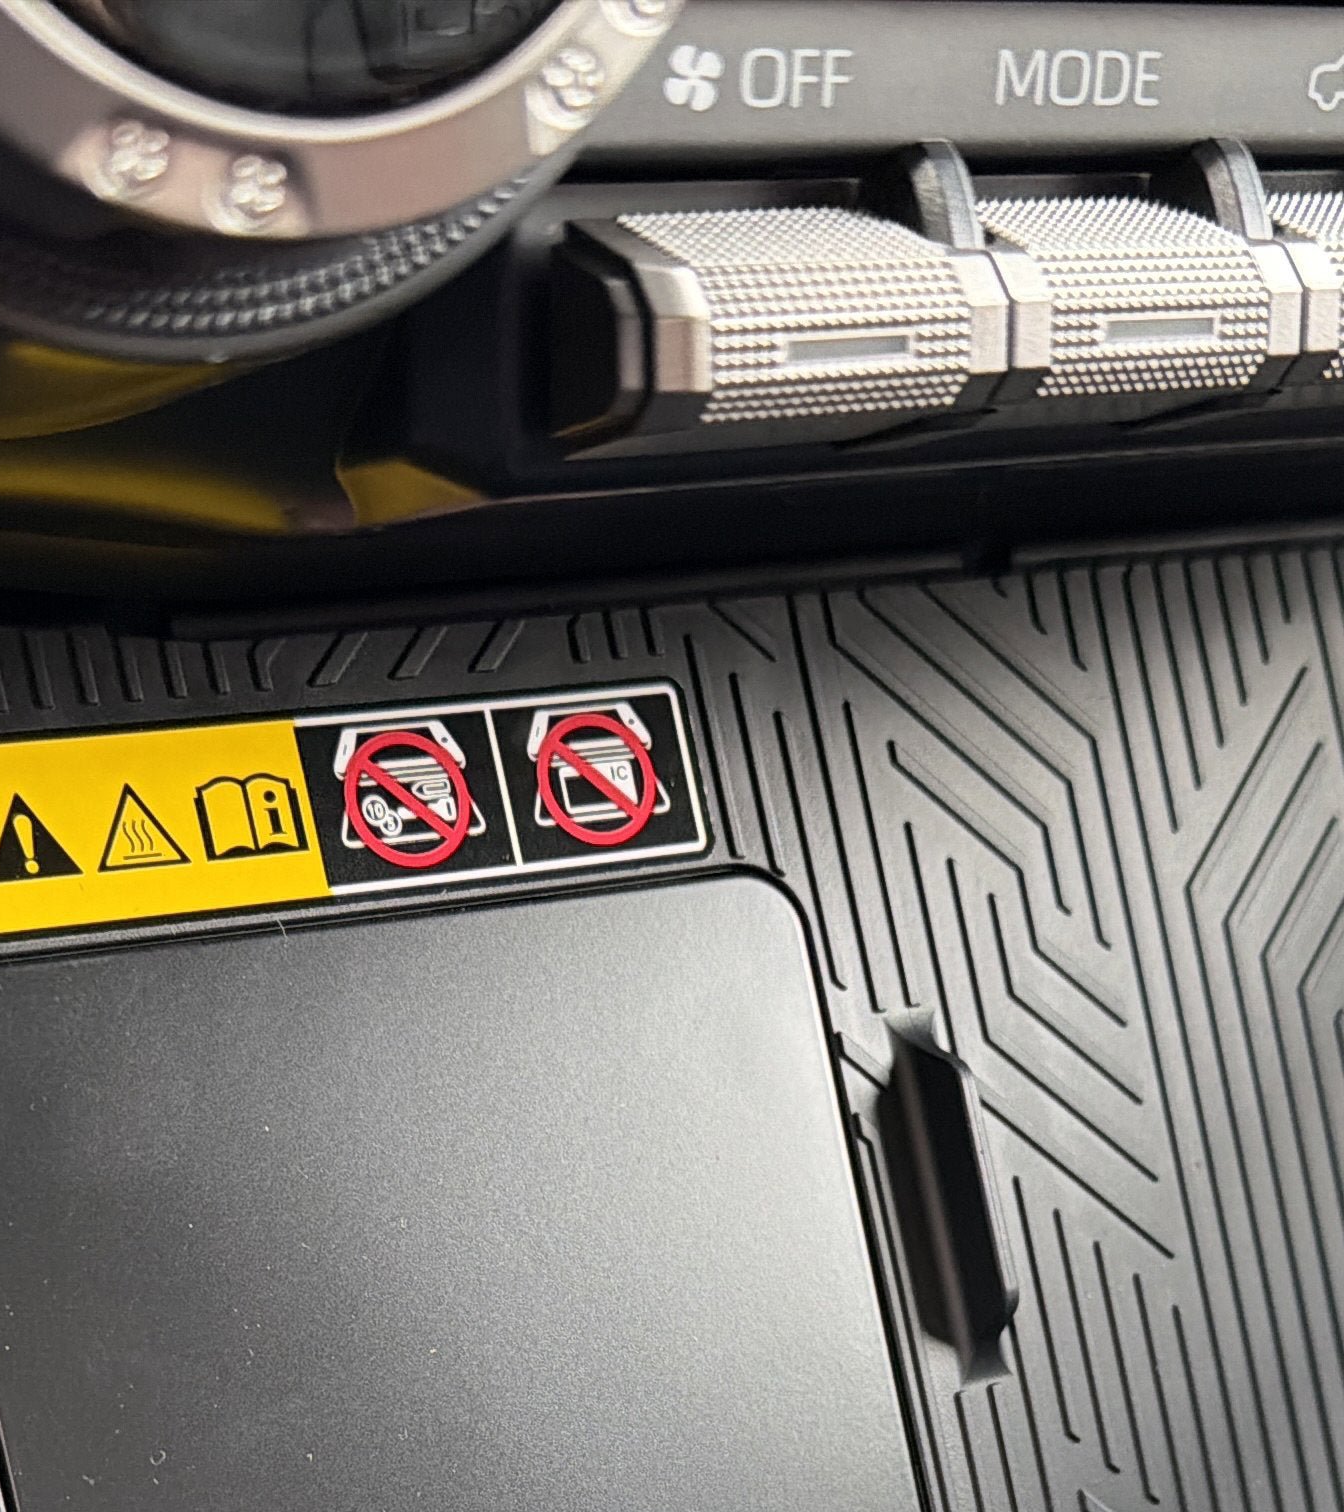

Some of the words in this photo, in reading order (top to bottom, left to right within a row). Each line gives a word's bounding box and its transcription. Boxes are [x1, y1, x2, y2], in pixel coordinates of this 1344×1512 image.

[739, 47, 854, 109] OFF
[995, 49, 1163, 107] MODE
[610, 765, 628, 781] IC
[366, 801, 385, 820] 10
